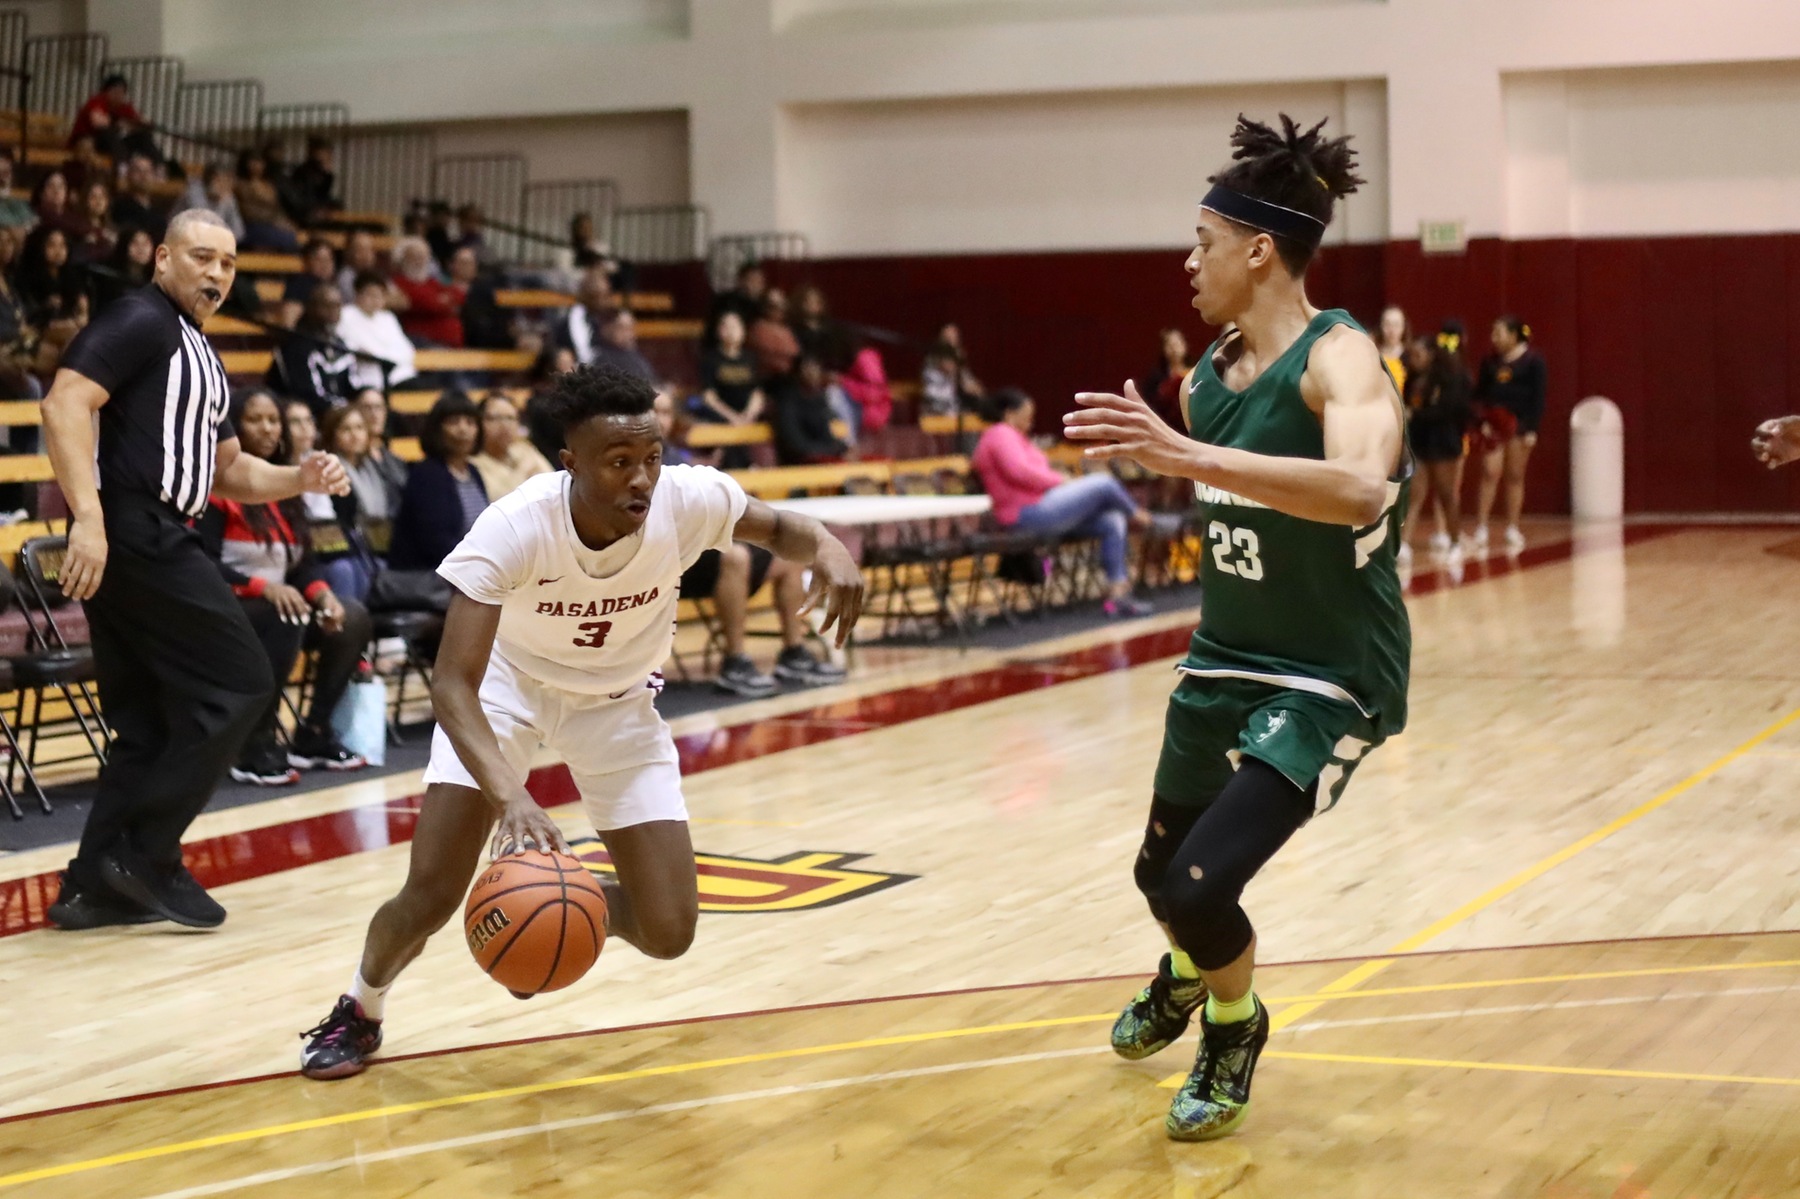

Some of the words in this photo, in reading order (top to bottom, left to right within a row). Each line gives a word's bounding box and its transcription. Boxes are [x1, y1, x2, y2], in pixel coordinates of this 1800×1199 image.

[1208, 519, 1264, 581] 23
[535, 586, 659, 617] PASADENA
[572, 620, 613, 648] 3
